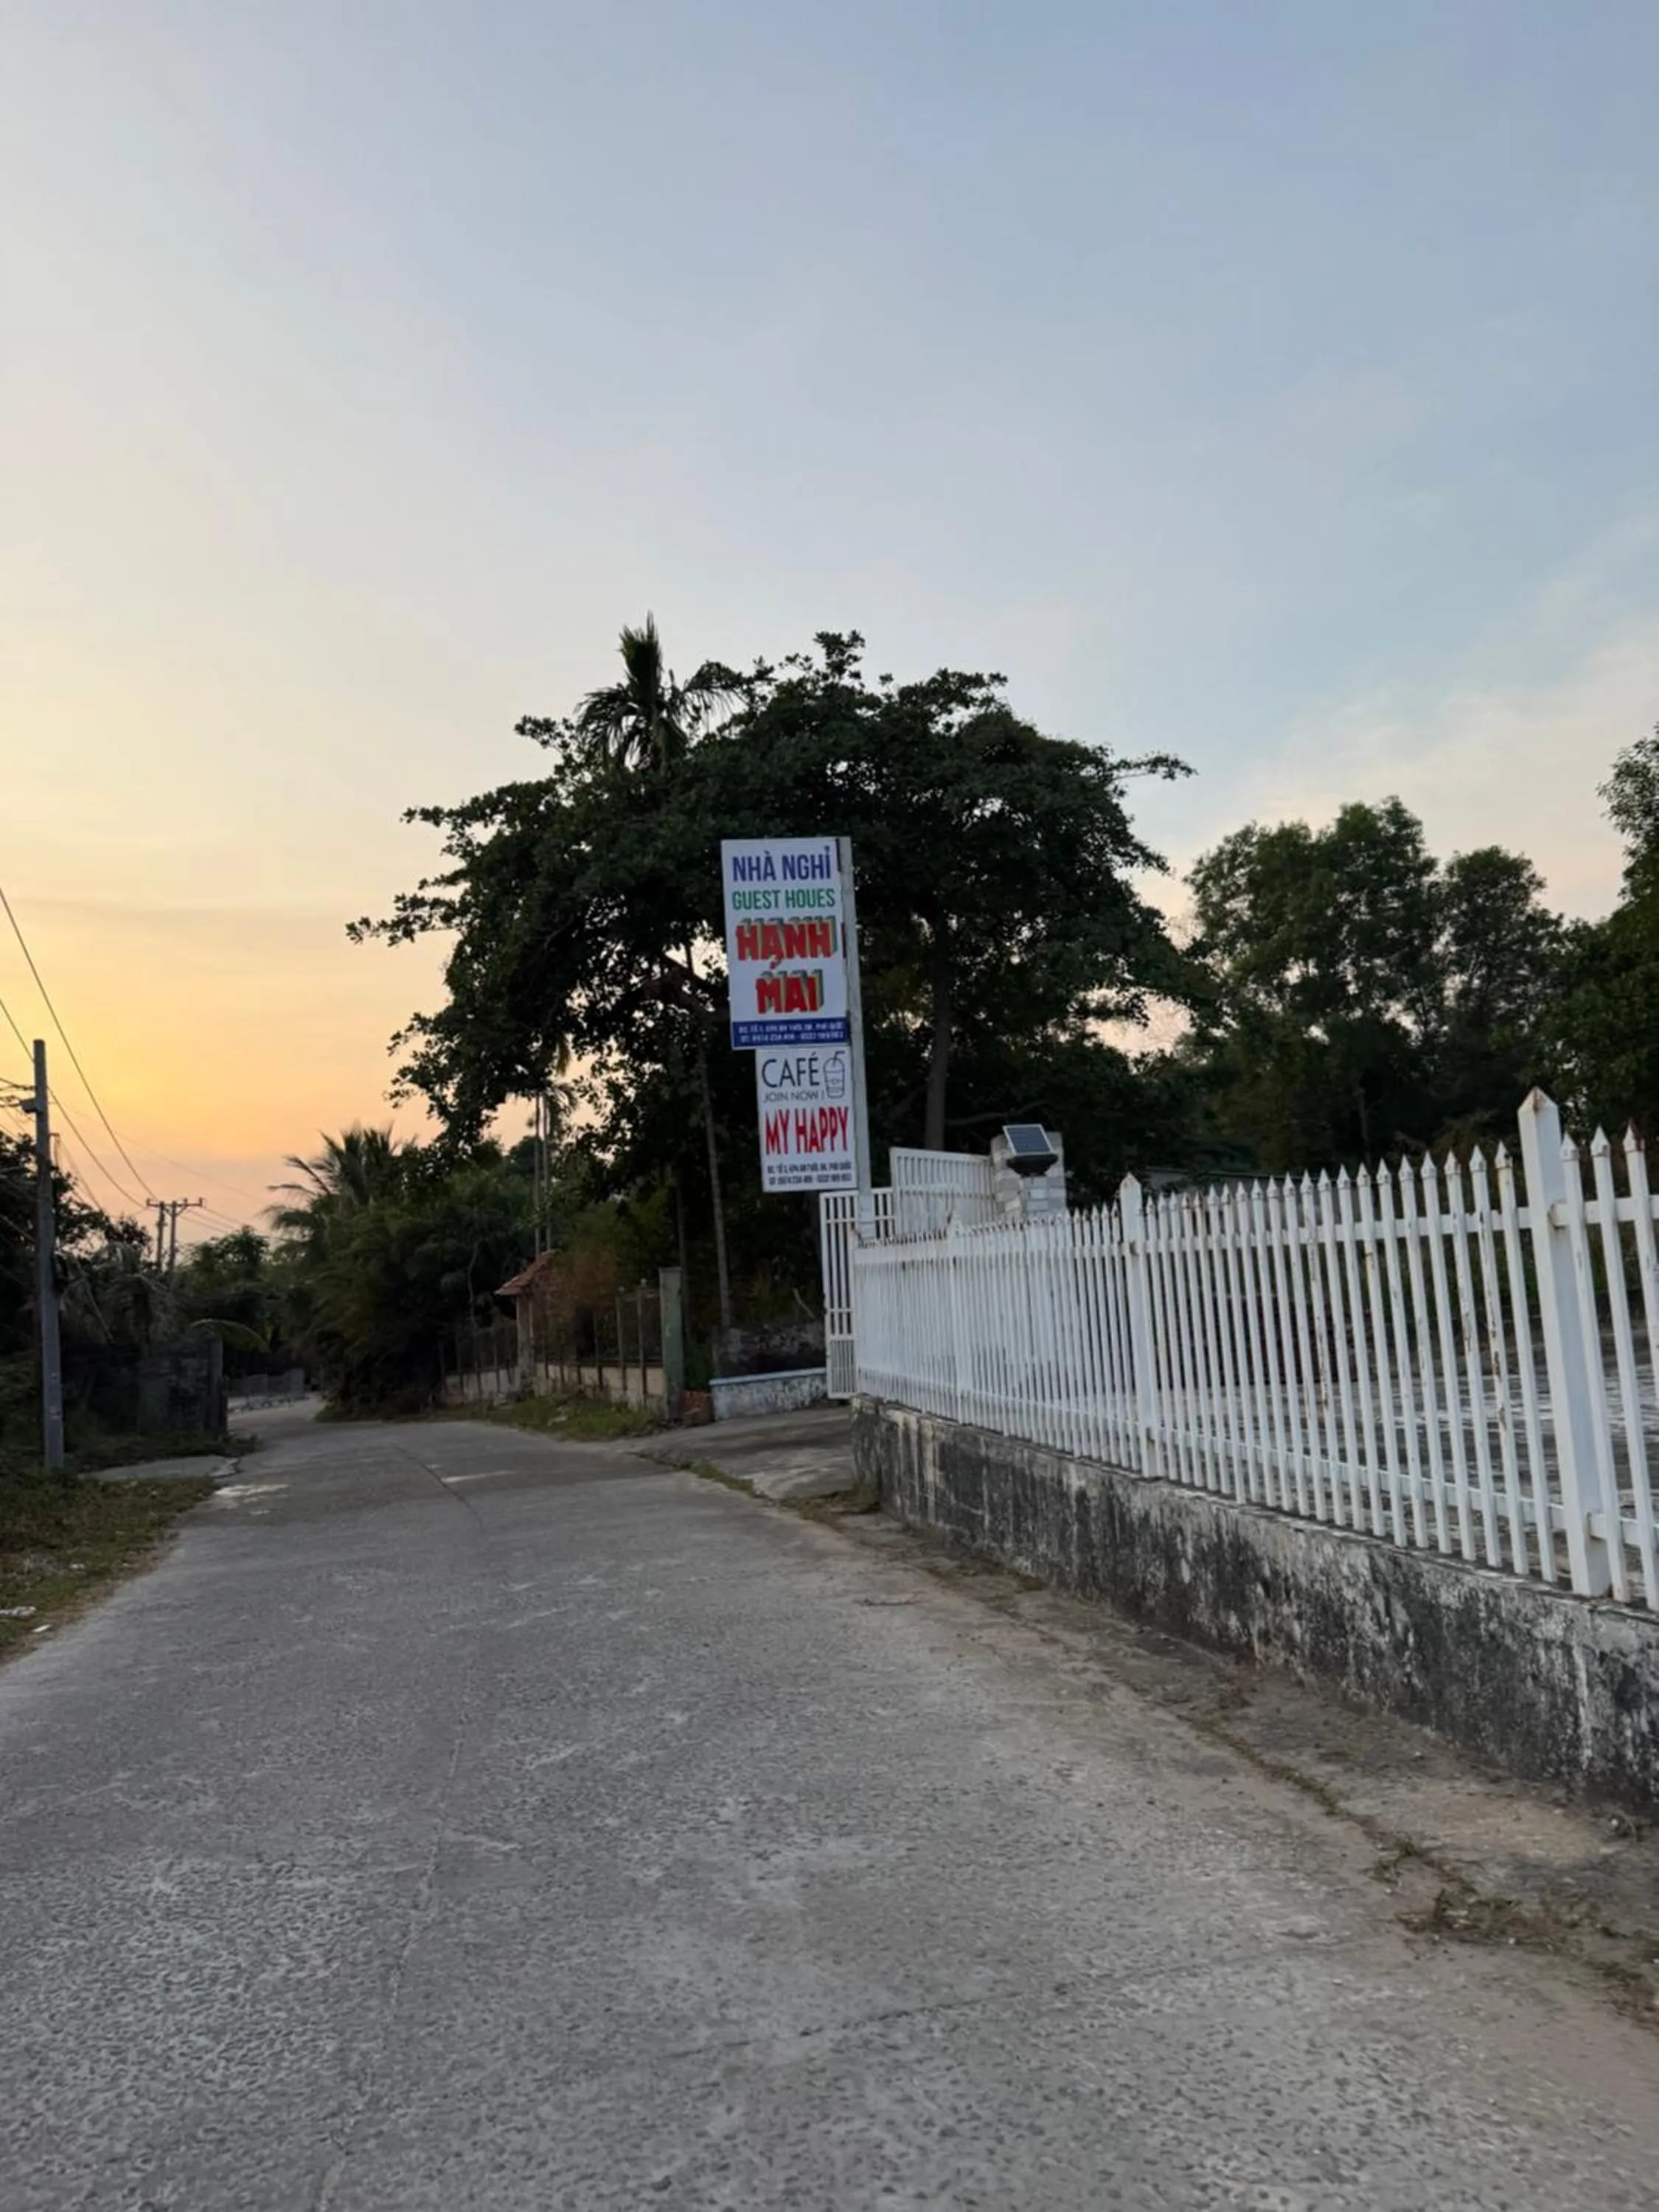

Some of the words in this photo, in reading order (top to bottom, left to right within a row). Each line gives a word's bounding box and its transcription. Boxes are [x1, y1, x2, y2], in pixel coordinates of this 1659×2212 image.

[732, 850, 776, 882] NHÀ
[731, 889, 781, 911] GUEST
[785, 888, 836, 908] HOUES
[755, 970, 824, 1015] MAI
[762, 1052, 821, 1088] CAFÉ
[764, 1092, 789, 1103] JOIN
[790, 1091, 819, 1102] NOW
[765, 1108, 790, 1156] MY
[794, 1107, 849, 1154] HAPPY
